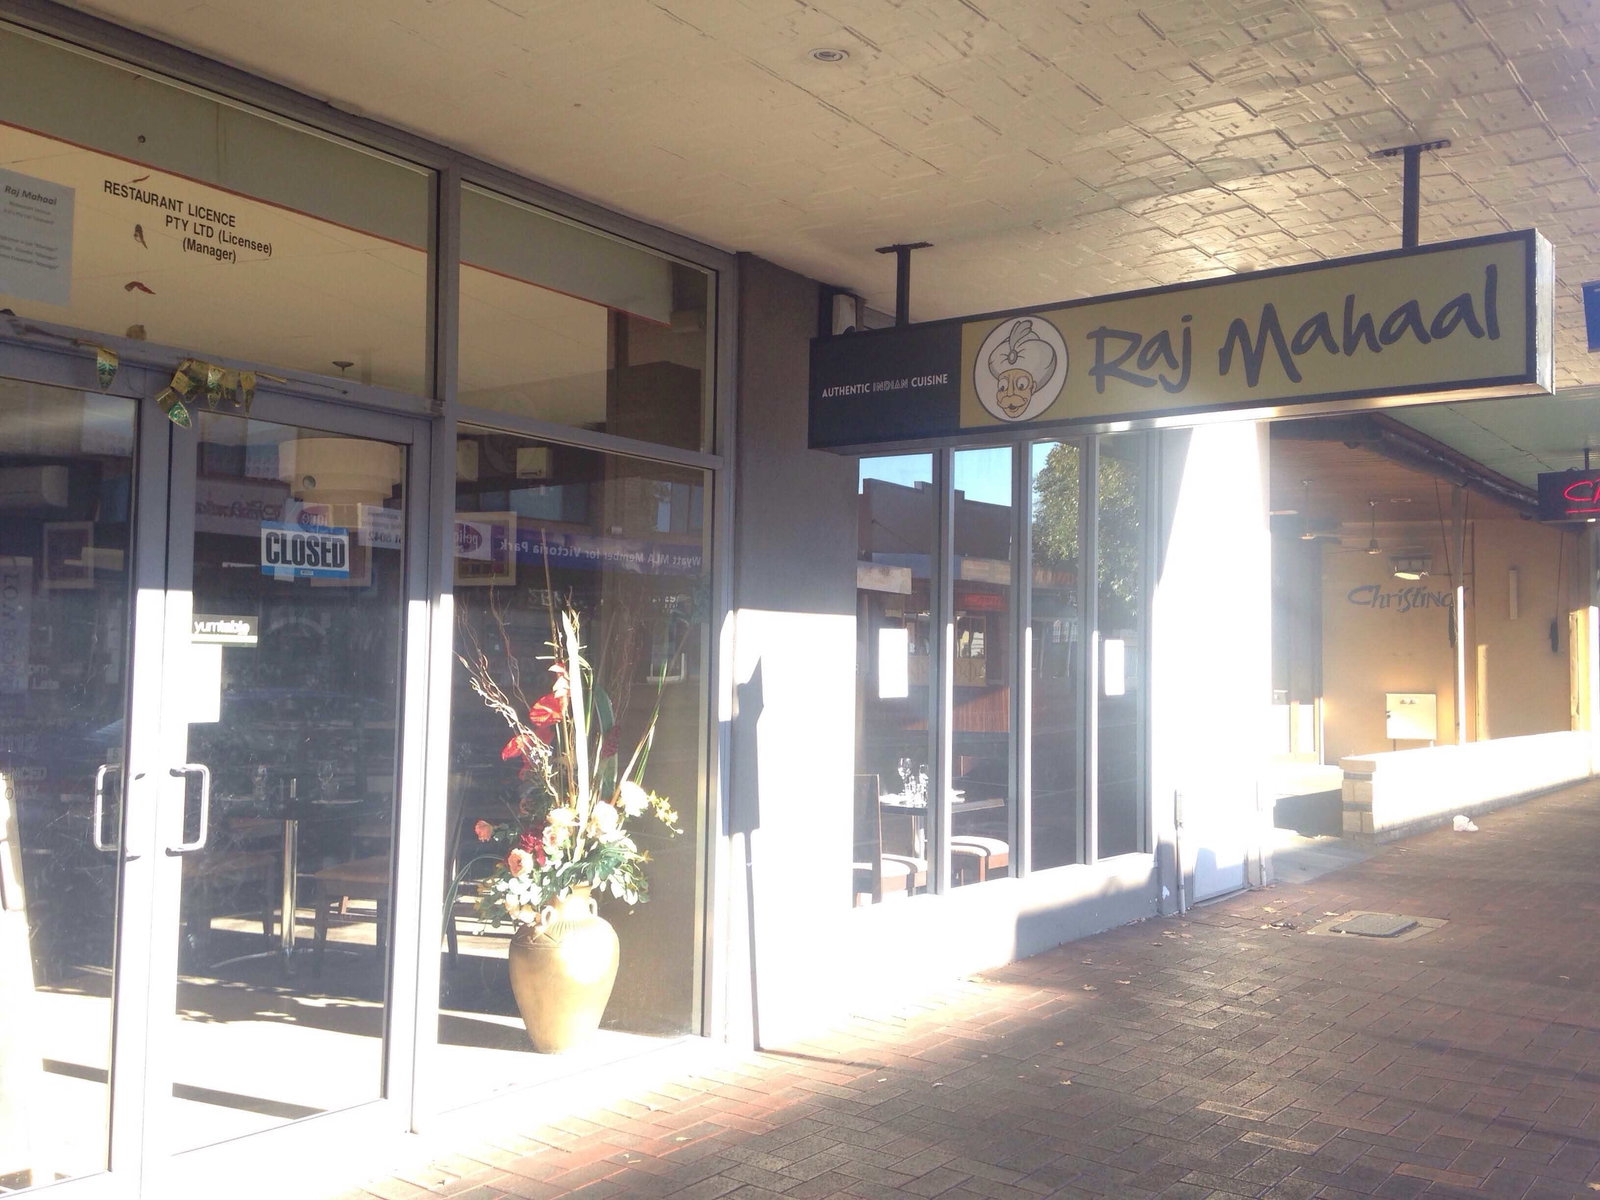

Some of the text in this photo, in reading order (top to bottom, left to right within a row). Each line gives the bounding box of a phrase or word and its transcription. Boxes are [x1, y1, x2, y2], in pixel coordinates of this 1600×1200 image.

[103, 180, 236, 228] RESTAURANT LICENCE
[165, 215, 273, 257] PTY LTD (Licensee)
[182, 237, 237, 264] (Manager)
[1086, 263, 1501, 394] Raj Mahaal
[822, 373, 949, 398] AUTHENTIC INDIAN CUISINE
[265, 531, 346, 569] CLOSED
